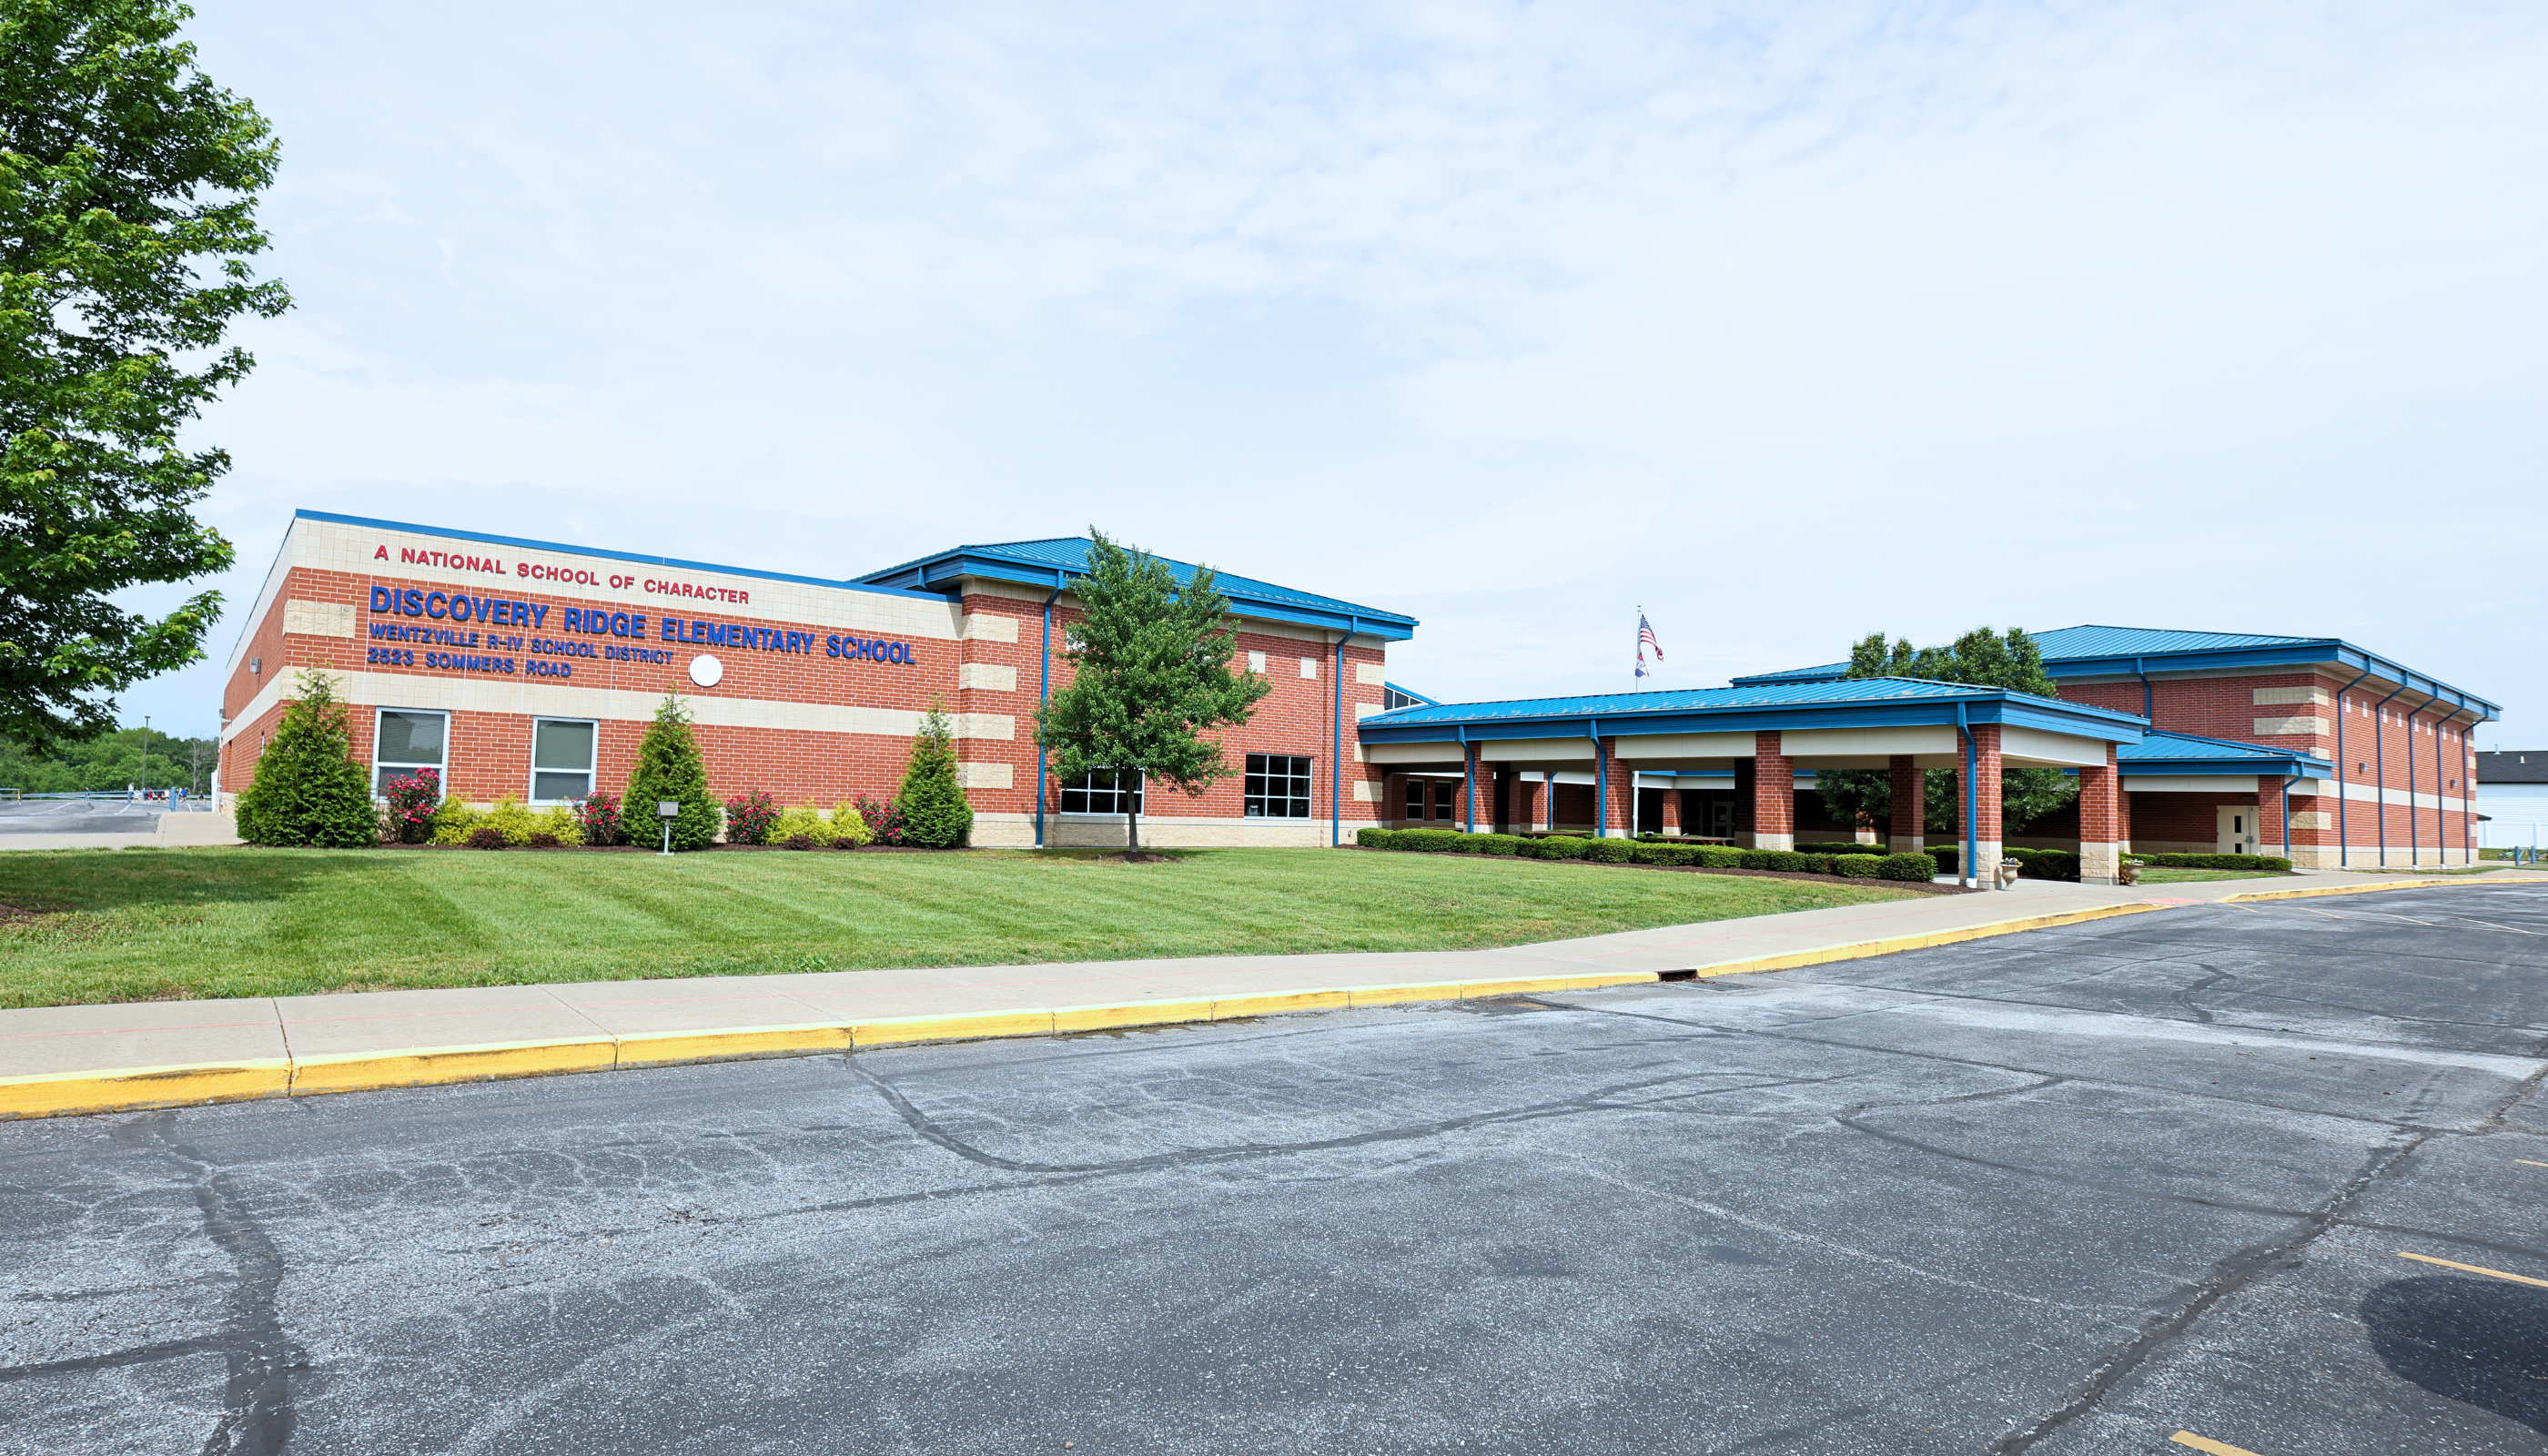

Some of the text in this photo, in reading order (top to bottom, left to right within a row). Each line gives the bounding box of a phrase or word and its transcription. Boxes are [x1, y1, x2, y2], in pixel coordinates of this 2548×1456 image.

[374, 545, 749, 603] A NATIONAL SCHOOL OF CHARACTER
[369, 585, 916, 664] DISCOVERY RIDGE ELEMENTARY SCHOOL
[369, 622, 673, 664] WENTZVILLE R-IV SCHOOL DISTRICT
[367, 646, 572, 677] 2523 SOMMERS ROAD
